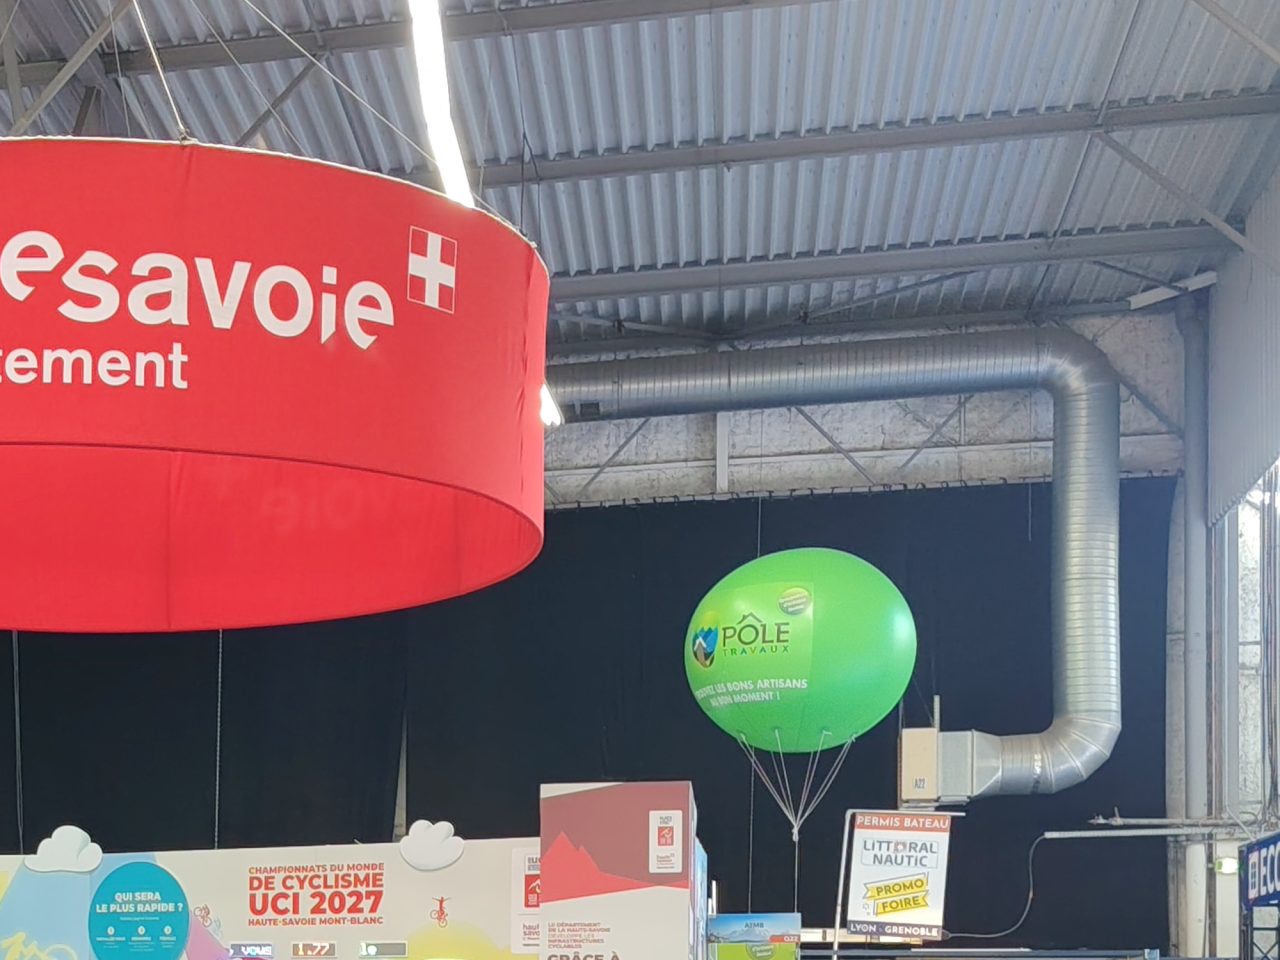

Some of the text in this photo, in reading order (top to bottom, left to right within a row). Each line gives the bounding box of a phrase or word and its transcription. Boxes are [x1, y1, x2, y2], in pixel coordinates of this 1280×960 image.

[722, 612, 790, 647] PÔLE
[722, 645, 790, 657] TRAVAUX
[726, 680, 753, 692] BONS
[757, 678, 808, 689] ARTISANS
[733, 691, 773, 703] MOMENT
[856, 815, 949, 829] PERMIS BATEAU
[248, 862, 385, 875] CHAMPIONNATS DU MONDE
[248, 872, 384, 891] DE CYCLISME
[876, 878, 925, 896] PROMO
[114, 892, 161, 902] QUI SERA
[248, 890, 384, 916] UCI 2027
[881, 895, 921, 912] FOIRE
[96, 902, 184, 912] LE PLUS RAPIDE ?
[248, 917, 384, 926] HAUTE-SAVOIE MONT-BLANC
[850, 923, 939, 937] LYON GRENOBLE
